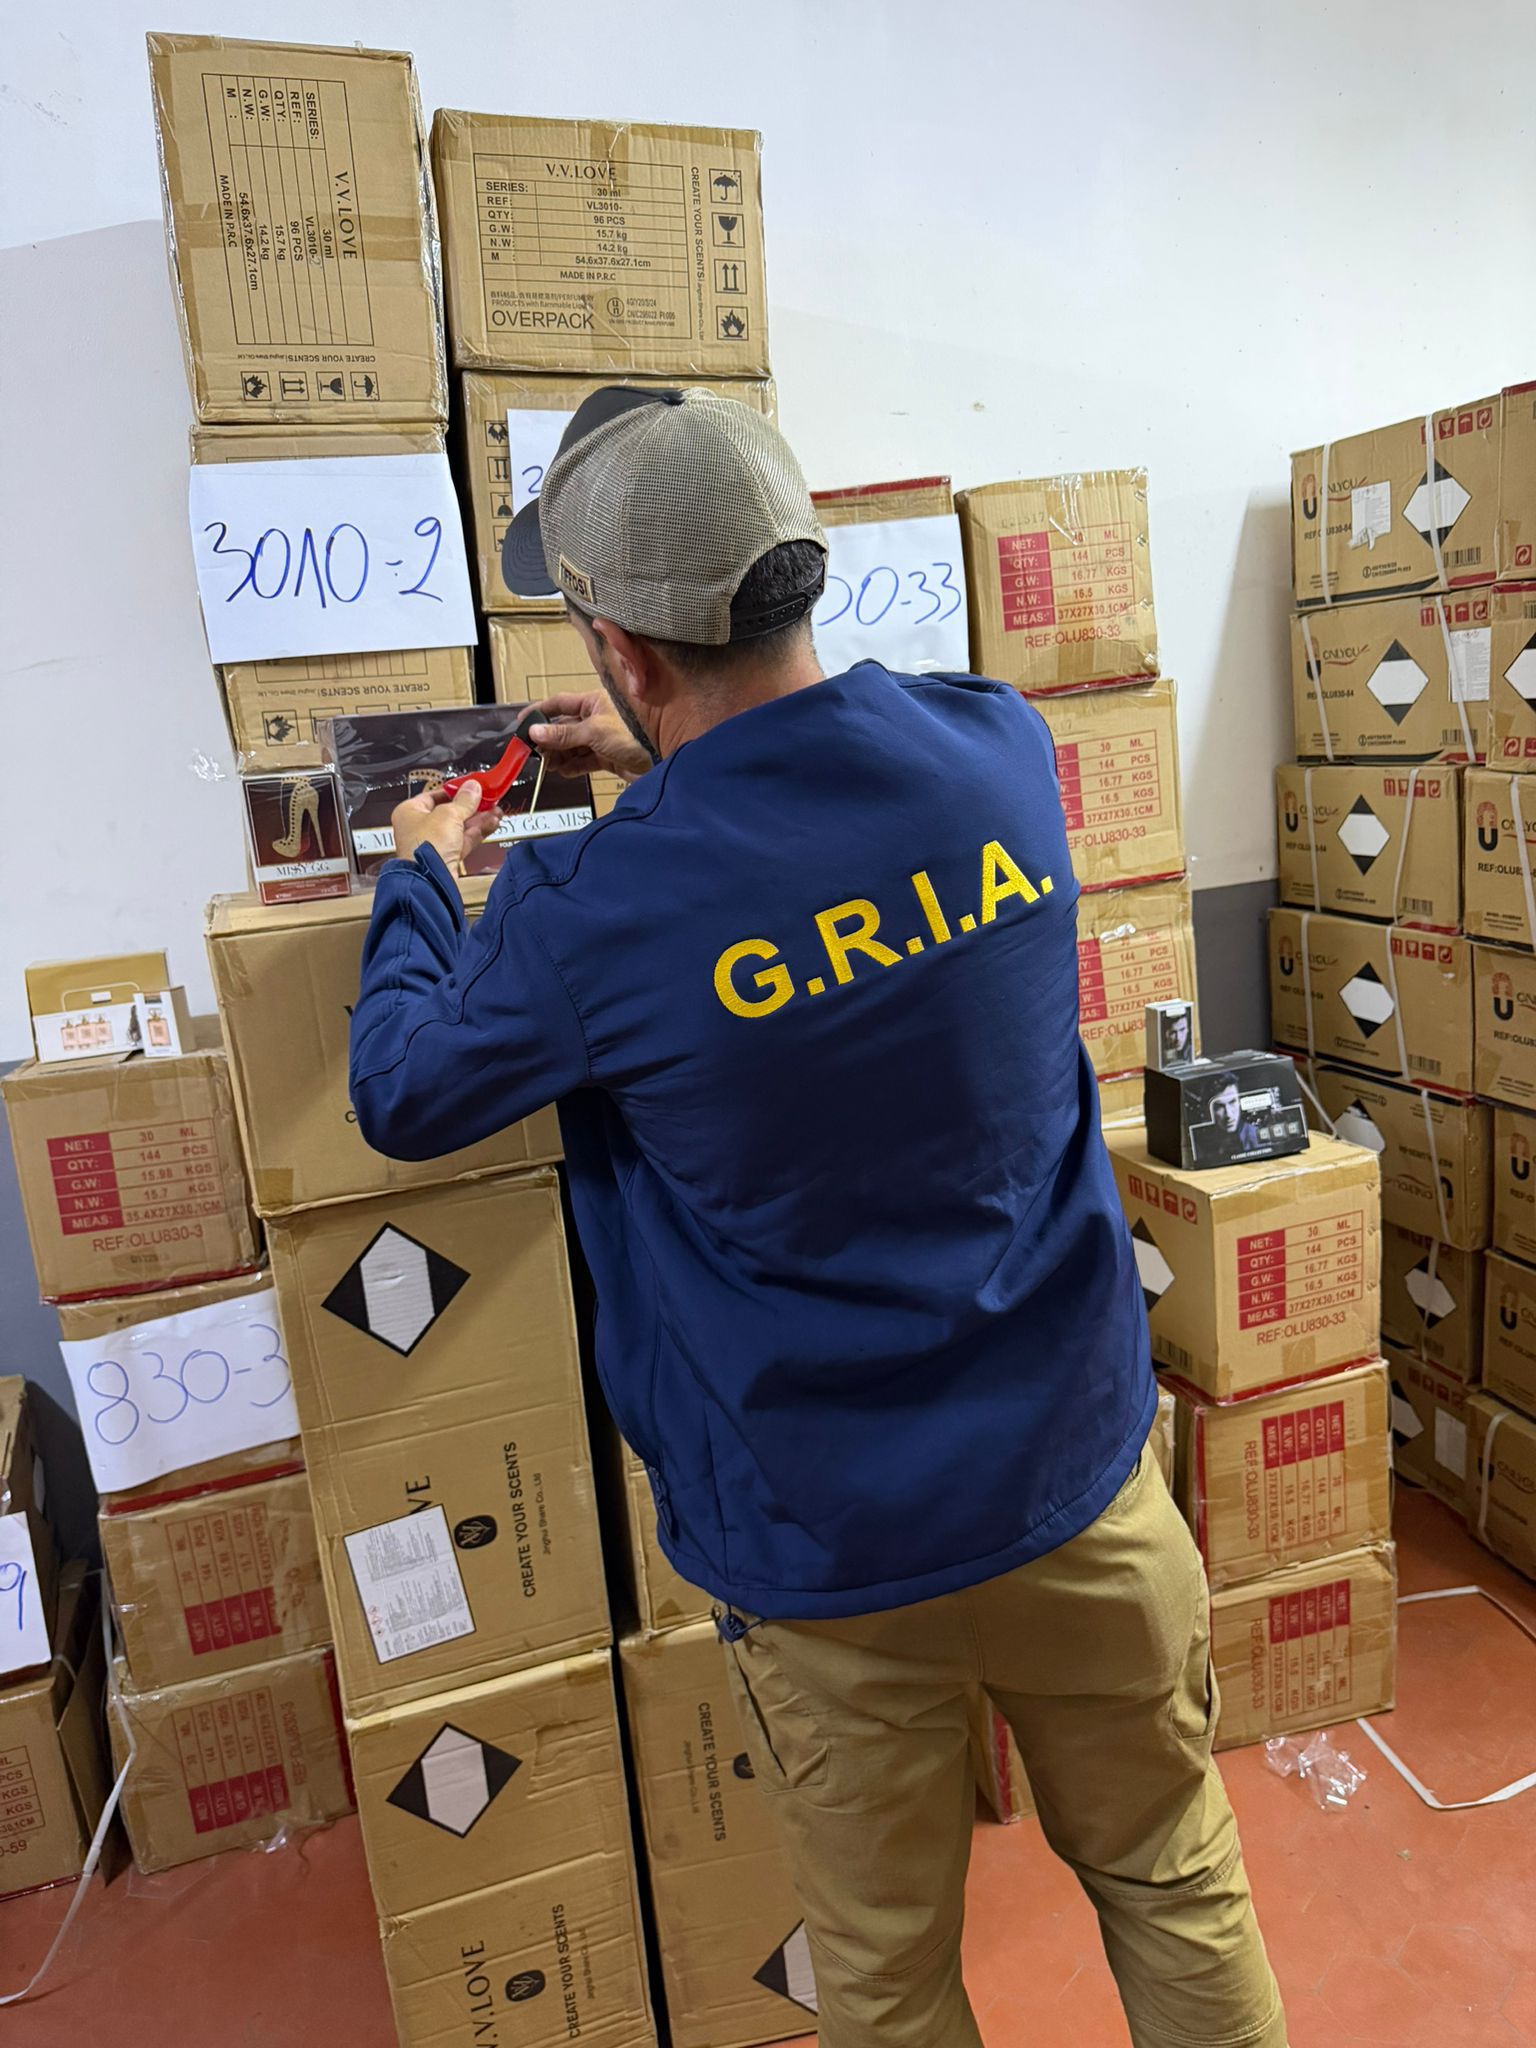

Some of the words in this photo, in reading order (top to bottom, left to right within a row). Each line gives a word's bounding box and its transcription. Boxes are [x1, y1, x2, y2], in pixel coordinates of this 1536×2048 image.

[242, 89, 255, 120] N.W:
[259, 89, 270, 121] G.W:
[274, 90, 287, 122] QTY:
[290, 91, 301, 123] REF:
[305, 92, 320, 140] SERIES:
[546, 163, 617, 181] V.V.LOVE
[220, 174, 231, 206] MADE
[486, 181, 528, 192] SERIES:
[597, 188, 607, 197] 30
[691, 166, 702, 206] CREATE
[487, 196, 513, 206] REF:
[224, 208, 234, 220] IN
[335, 171, 358, 260] V.V.LOVE
[488, 210, 514, 220] QTY:
[594, 216, 605, 224] 96
[606, 216, 626, 225] PCS
[694, 207, 703, 236] YOUR
[259, 224, 270, 248] 14.2
[275, 225, 285, 248] 15.7
[290, 221, 299, 234] 96
[322, 229, 332, 241] 30
[489, 224, 515, 234] G.W:
[596, 229, 614, 239] 15.7
[616, 230, 628, 241] kg
[261, 249, 270, 261] kg
[277, 249, 286, 261] kg
[294, 237, 304, 262] PCS
[325, 244, 334, 259] ml
[490, 238, 516, 248] N.W:
[597, 243, 615, 252] 14.2
[617, 244, 628, 255] kg
[560, 271, 585, 280] MADE
[586, 271, 596, 280] IN
[492, 309, 595, 330] OVERPACK
[289, 354, 320, 362] SCENTS
[322, 355, 344, 363] YOUR
[346, 355, 376, 363] CREATE
[1012, 540, 1036, 550] NET:
[1104, 529, 1118, 540] ML
[1013, 558, 1038, 570] QTY:
[1072, 550, 1088, 561] 144
[1105, 548, 1125, 558] PCS
[1014, 576, 1040, 588] G.W:
[1072, 568, 1097, 581] 16.77
[1106, 566, 1127, 577] KGS
[1016, 594, 1041, 607] N.W:
[1074, 587, 1093, 600] 16.5
[1108, 584, 1128, 595] KGS
[1013, 613, 1046, 626] MEAS:
[361, 683, 392, 695] YOUR
[398, 682, 431, 693] CREATE
[1130, 738, 1144, 749] ML
[1100, 759, 1115, 770] 144
[1130, 755, 1150, 766] PCS
[1099, 775, 1122, 788] 16.77
[1132, 771, 1153, 782] KGS
[1100, 793, 1120, 805] 16.5
[1133, 788, 1154, 798] KGS
[713, 839, 1055, 1018] G.R.I.A.
[1120, 951, 1136, 962] 144
[1150, 946, 1169, 958] PCS
[1120, 966, 1144, 980] 16.77
[1152, 962, 1172, 974] KGS
[1122, 984, 1140, 996] 16.5
[1154, 977, 1174, 989] KGS
[64, 1138, 95, 1152] NET:
[139, 1130, 154, 1142] 30
[180, 1126, 198, 1139] ML
[67, 1158, 98, 1172] QTY:
[140, 1150, 161, 1162] 144
[182, 1144, 208, 1157] PCS
[185, 1164, 214, 1176] KGS
[74, 1196, 104, 1212] N.W:
[144, 1188, 169, 1201] 15.7
[188, 1182, 216, 1195] KGS
[72, 1214, 114, 1230] MEAS:
[92, 1224, 204, 1252] REF:OLU830-3
[1250, 1237, 1274, 1250] NET:
[1308, 1226, 1318, 1238] 30
[1336, 1218, 1351, 1230] ML
[1250, 1254, 1275, 1269] QTY:
[1306, 1244, 1322, 1256] 144
[1336, 1236, 1357, 1248] PCS
[1250, 1273, 1274, 1287] G.W:
[1304, 1260, 1328, 1274] 16.77
[1336, 1254, 1358, 1266] KGS
[1250, 1291, 1275, 1306] N.W:
[1304, 1279, 1324, 1293] 16.5
[1336, 1271, 1358, 1284] KGS
[1247, 1308, 1279, 1324] MEAS:
[1256, 1310, 1346, 1346] REF:OLU830-33
[504, 1440, 523, 1499] SCENTS
[512, 1501, 528, 1542] YOUR
[518, 1544, 536, 1598] CREATE
[698, 1702, 715, 1752] CREATE
[705, 1754, 720, 1789] YOUR
[2, 1785, 29, 1800] KGS
[6, 1801, 33, 1816] KGS
[708, 1792, 726, 1842] SCENTS
[552, 1904, 569, 1953] SCENTS
[558, 1955, 574, 1990] YOUR
[564, 1992, 582, 2039] CREATE
